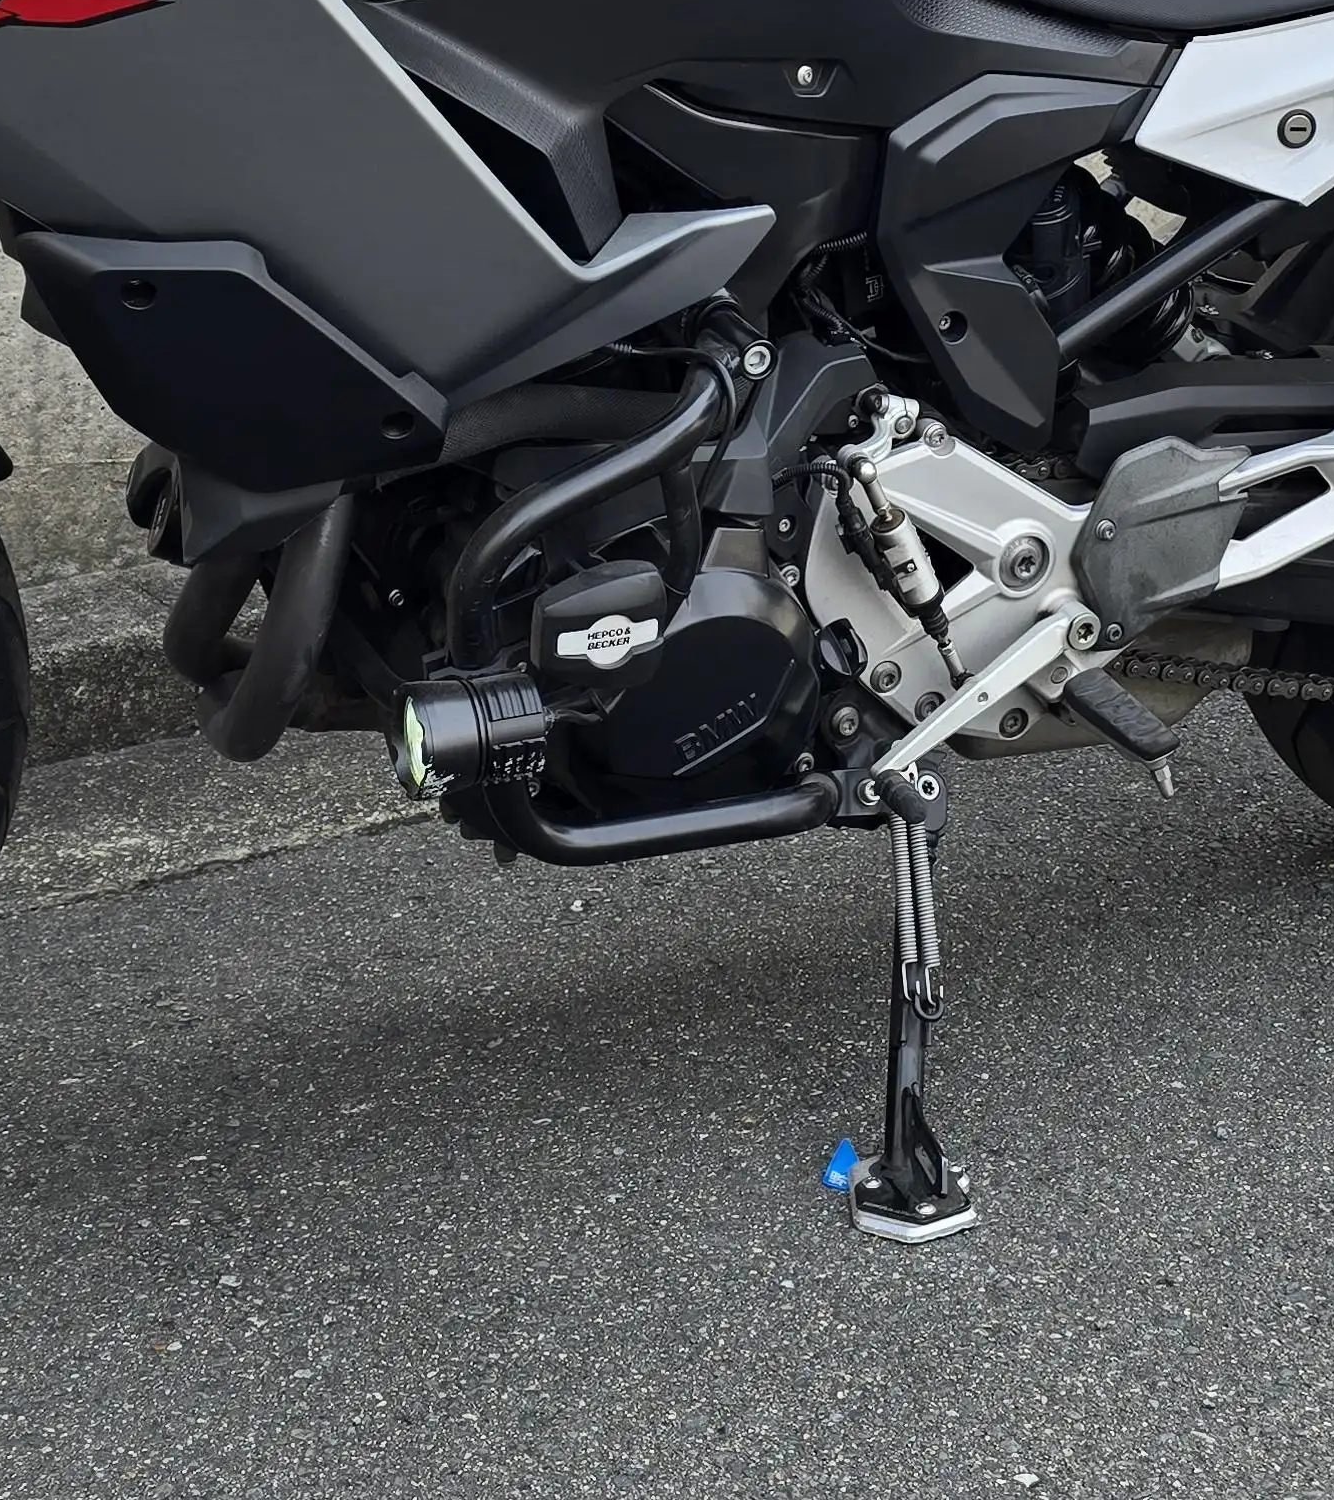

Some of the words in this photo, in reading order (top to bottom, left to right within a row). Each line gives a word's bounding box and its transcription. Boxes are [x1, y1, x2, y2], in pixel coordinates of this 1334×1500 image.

[587, 628, 623, 641] HEPCO
[624, 626, 631, 635] &
[587, 636, 630, 650] BECKER
